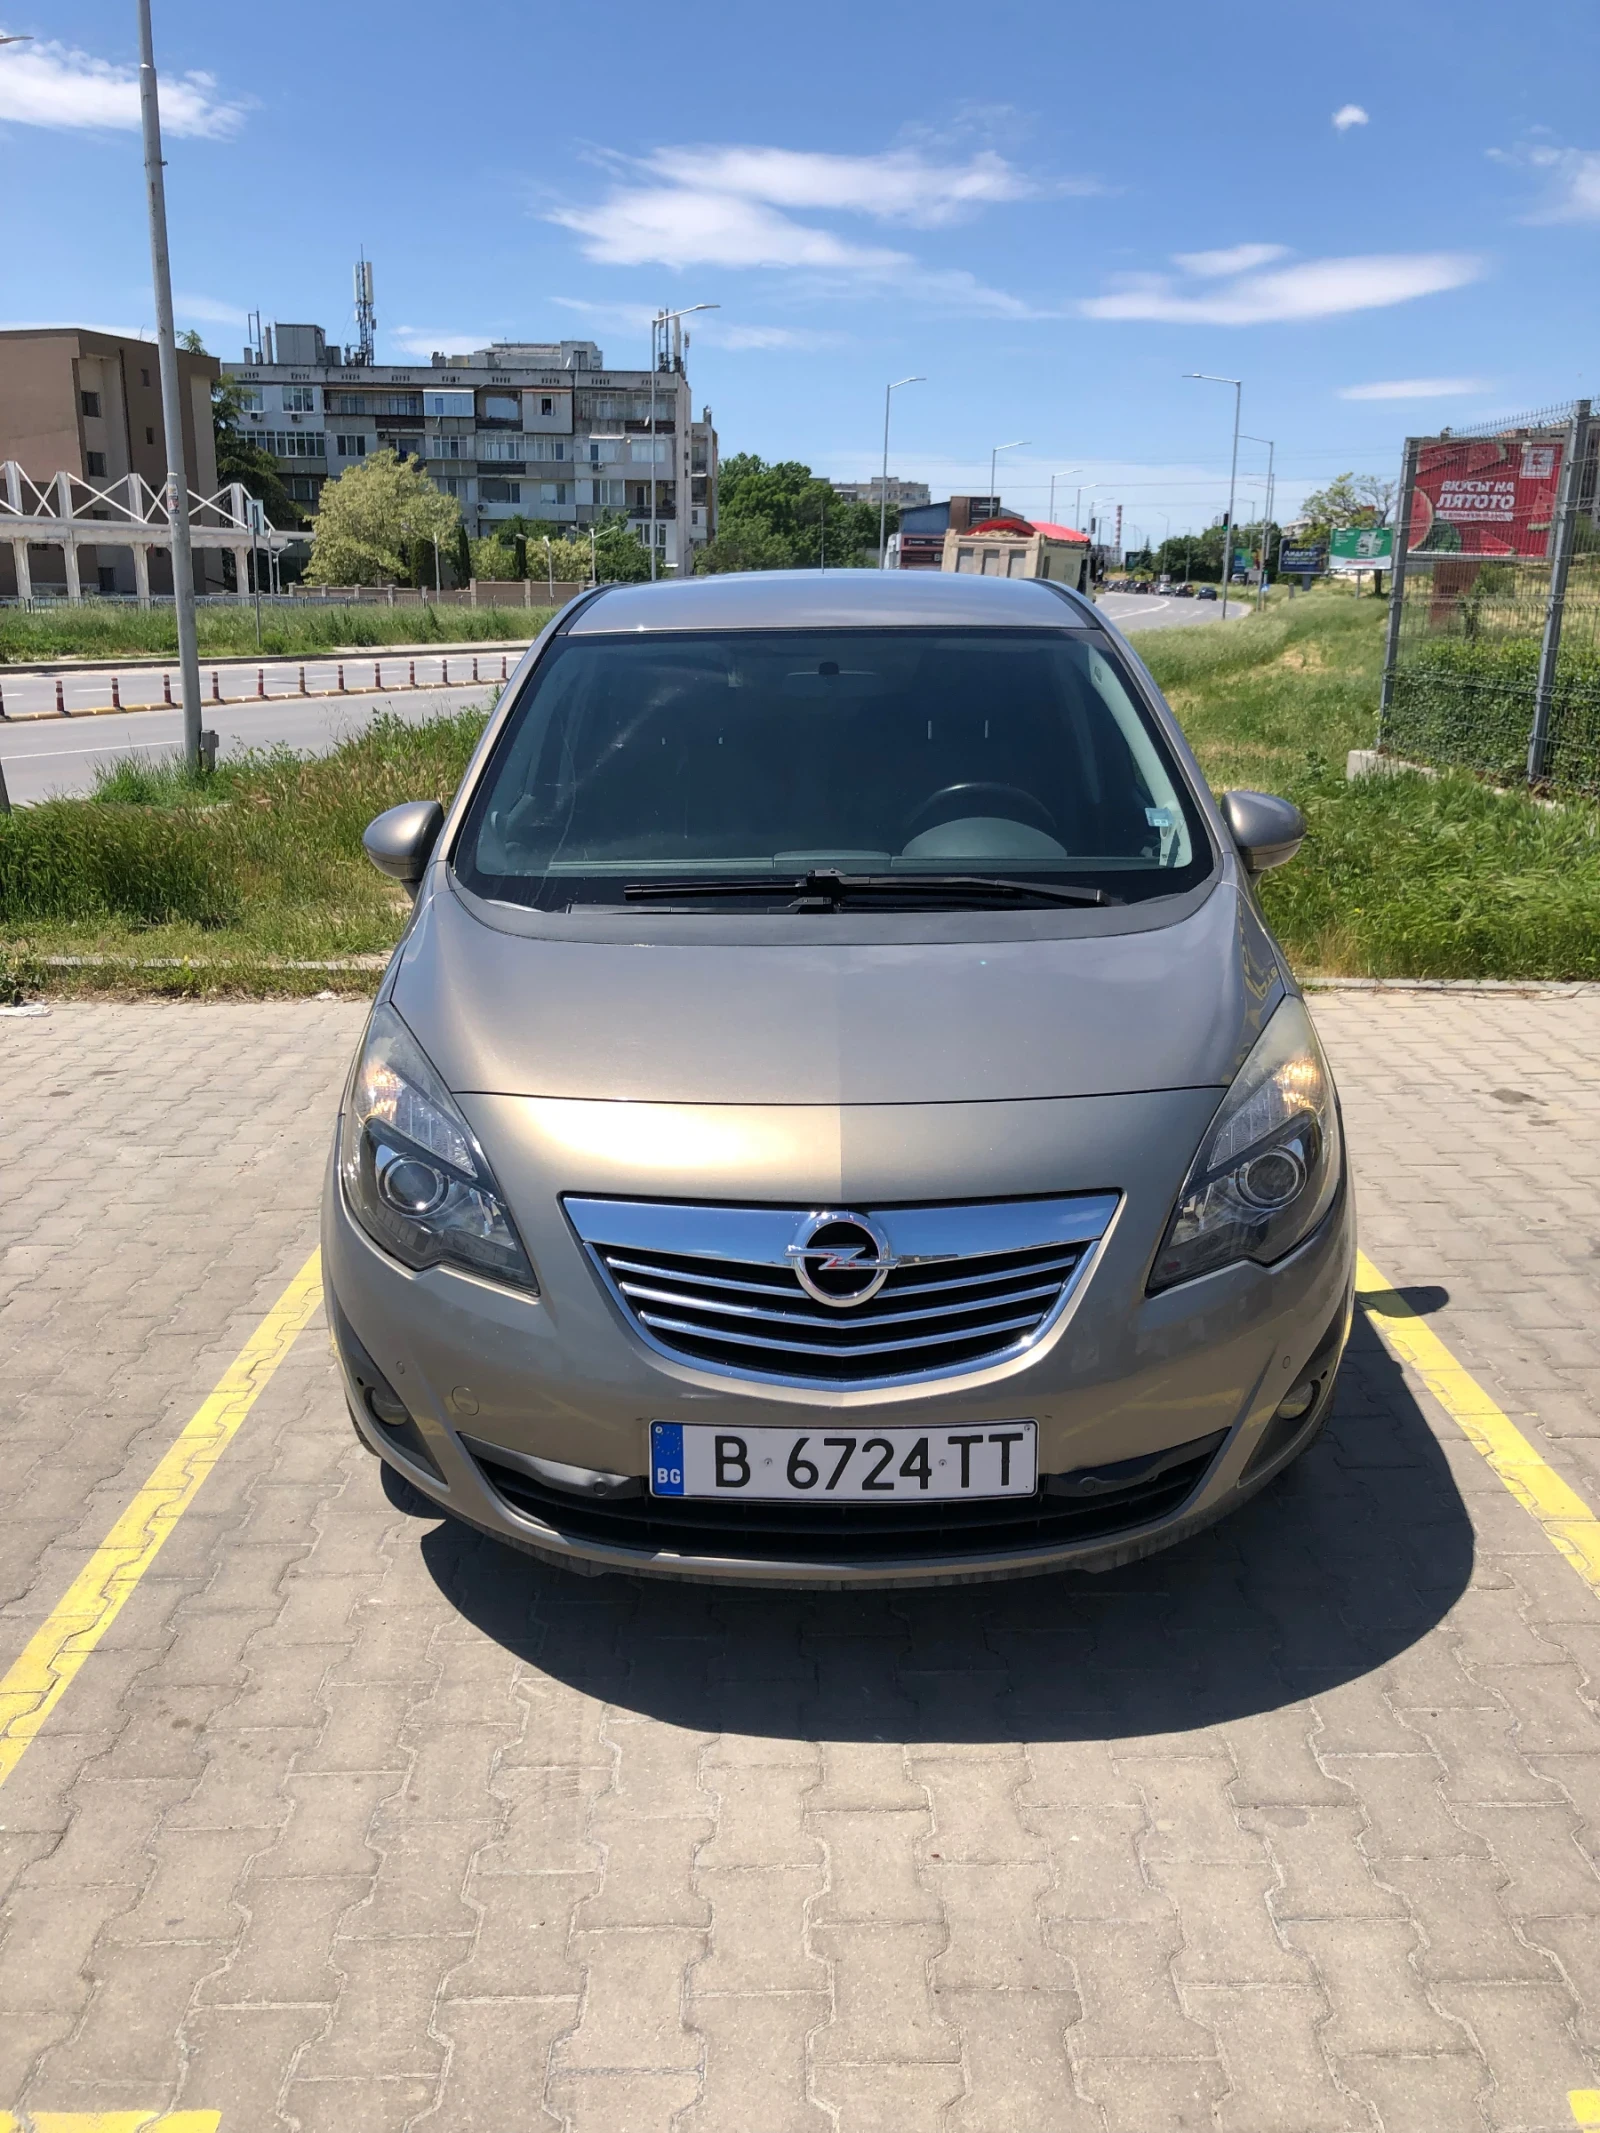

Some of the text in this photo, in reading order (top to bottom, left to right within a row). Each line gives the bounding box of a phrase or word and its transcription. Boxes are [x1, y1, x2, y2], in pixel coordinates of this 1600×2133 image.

[1441, 480, 1515, 493] ВКУСЪТ НА
[1435, 493, 1515, 509] ЛЯТОТО
[714, 1433, 1024, 1491] B 6724 TT
[657, 1468, 681, 1484] BG
